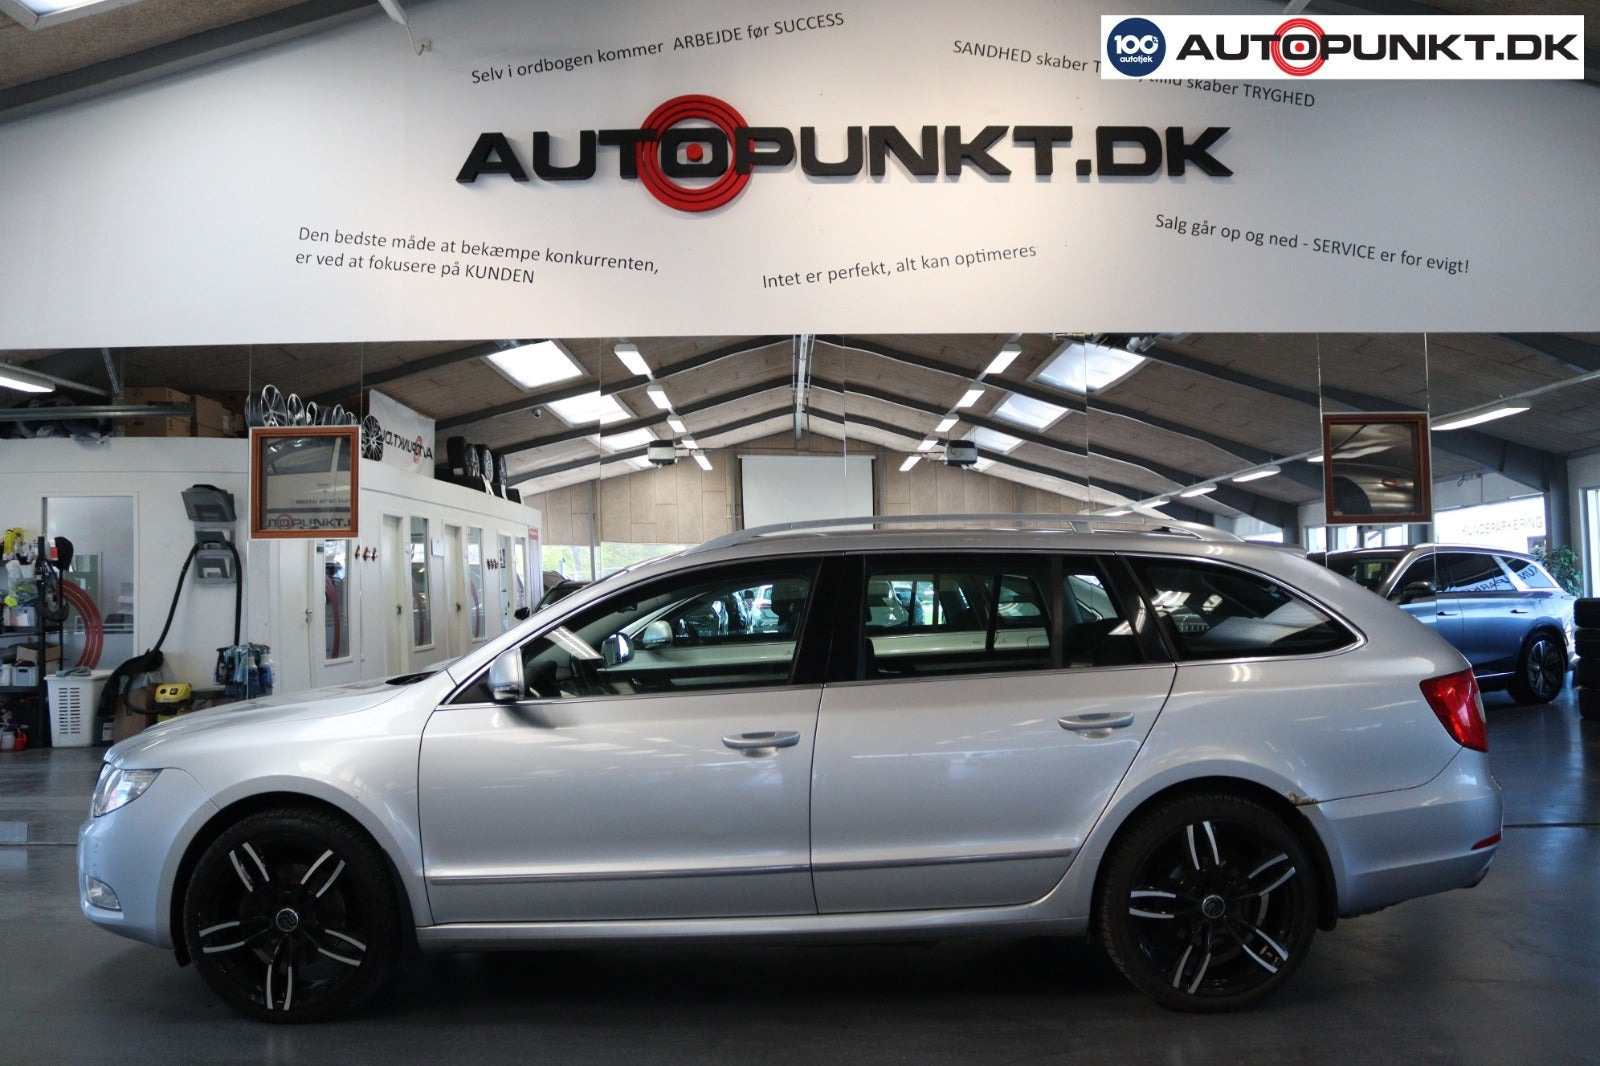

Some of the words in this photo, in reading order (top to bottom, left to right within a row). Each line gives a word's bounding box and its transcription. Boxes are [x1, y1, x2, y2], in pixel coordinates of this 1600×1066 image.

[471, 66, 504, 85] Selv
[507, 64, 513, 78] i
[516, 54, 593, 74] ordbogen
[597, 42, 664, 63] kommer
[673, 26, 743, 52] ARBEJDE
[746, 24, 770, 40] før
[773, 12, 845, 35] SUCCESS
[952, 39, 1032, 64] SANDHED
[1035, 51, 1089, 72] skaber
[1242, 83, 1315, 108] TRYGHED
[456, 124, 1234, 185] AUTOPUNKT.DK
[295, 253, 313, 265] er
[316, 252, 345, 267] ved
[348, 255, 365, 269] at
[368, 254, 437, 274] fokusere
[440, 260, 461, 279] på
[465, 263, 535, 284] KUNDEN
[298, 226, 330, 243] Den
[334, 228, 387, 248] bedste
[391, 234, 436, 252] måde
[440, 240, 457, 254] at
[460, 239, 541, 263] bekæmpe
[545, 247, 659, 276] konkurrenten,
[762, 271, 802, 289] Intet
[805, 271, 823, 284] er
[827, 261, 892, 285] perfekt,
[896, 256, 918, 273] alt
[920, 254, 950, 270] kan
[954, 245, 1037, 268] optimeres
[1154, 213, 1188, 235] Salg
[1190, 219, 1217, 237] går
[1220, 227, 1241, 243] op
[1245, 230, 1265, 247] og
[1268, 234, 1299, 249] ned
[1312, 237, 1376, 261] SERVICE
[1379, 250, 1397, 263] er
[1400, 249, 1423, 267] for
[1426, 256, 1469, 276] evigt!
